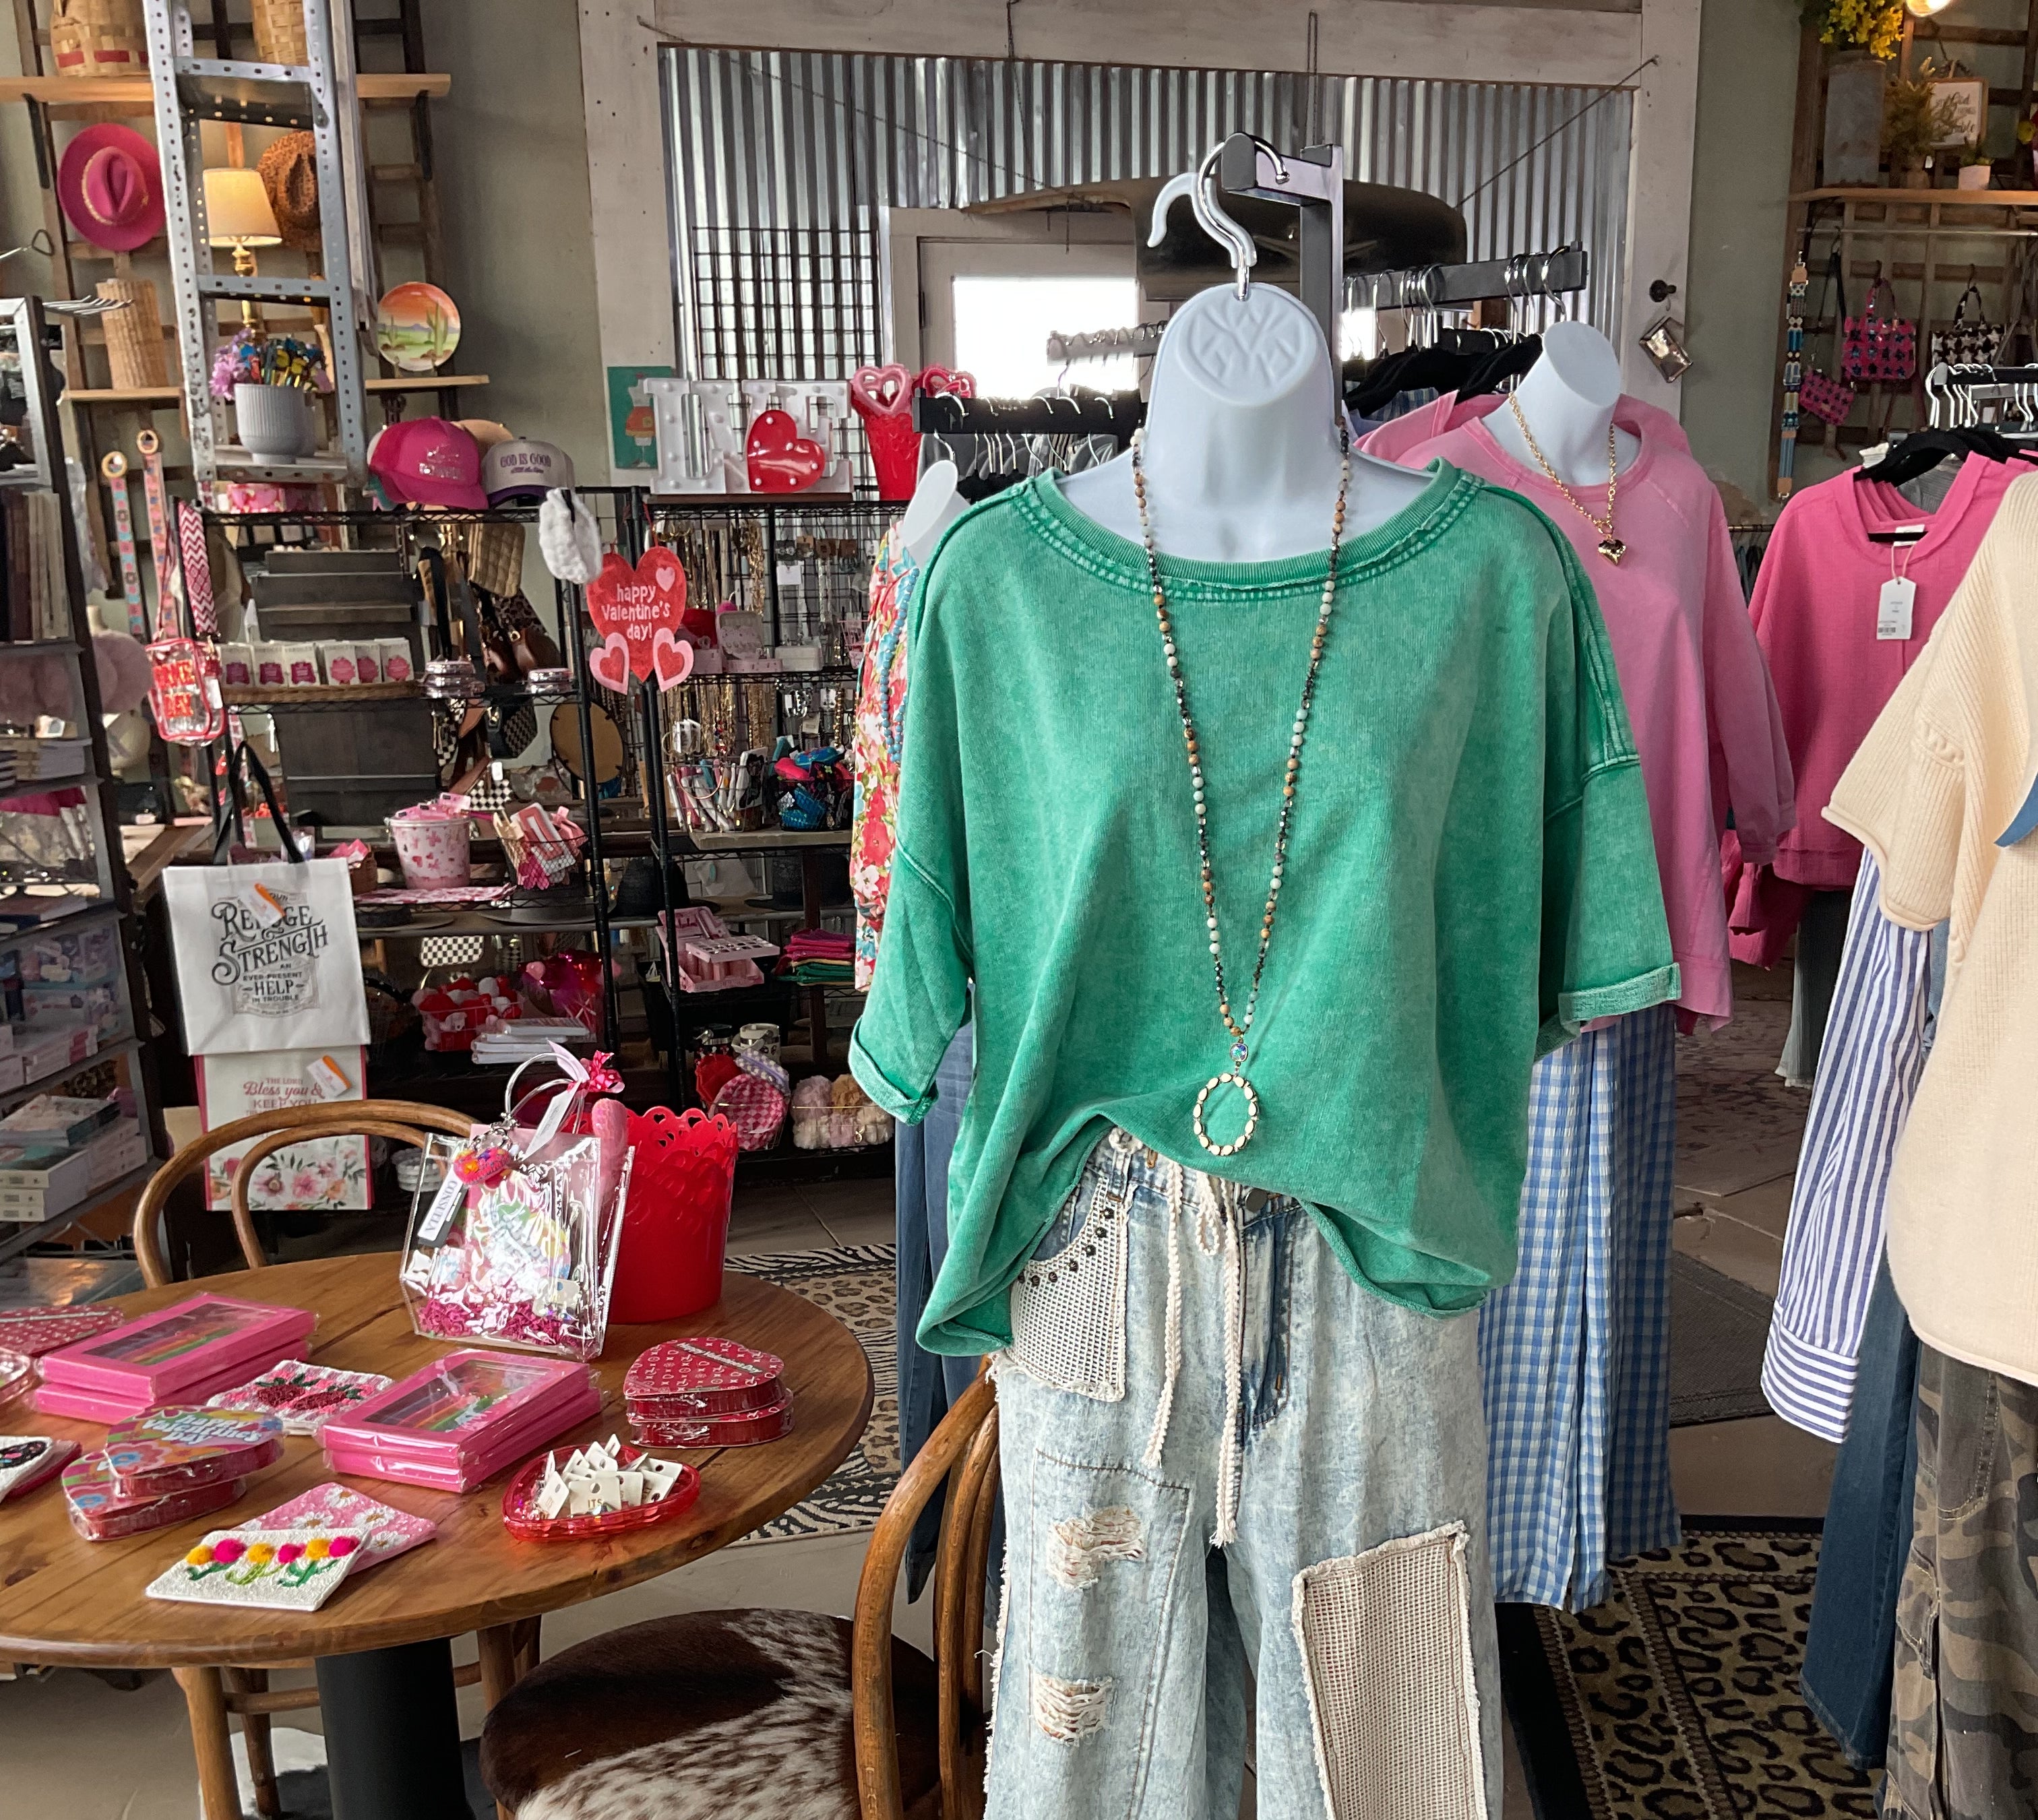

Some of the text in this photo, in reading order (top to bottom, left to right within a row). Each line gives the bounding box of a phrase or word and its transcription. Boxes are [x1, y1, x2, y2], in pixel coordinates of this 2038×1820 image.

[500, 453, 551, 468] GOD IS GOOD
[617, 582, 656, 604] happy
[601, 600, 671, 621] Valentine's
[627, 622, 652, 641] day!
[212, 924, 329, 986] STRENGTH
[254, 980, 294, 996] HELP
[264, 995, 299, 1003] TROUBLE
[243, 1081, 280, 1096] Bless
[278, 1086, 309, 1101] you
[425, 1179, 458, 1232] CONSUELA
